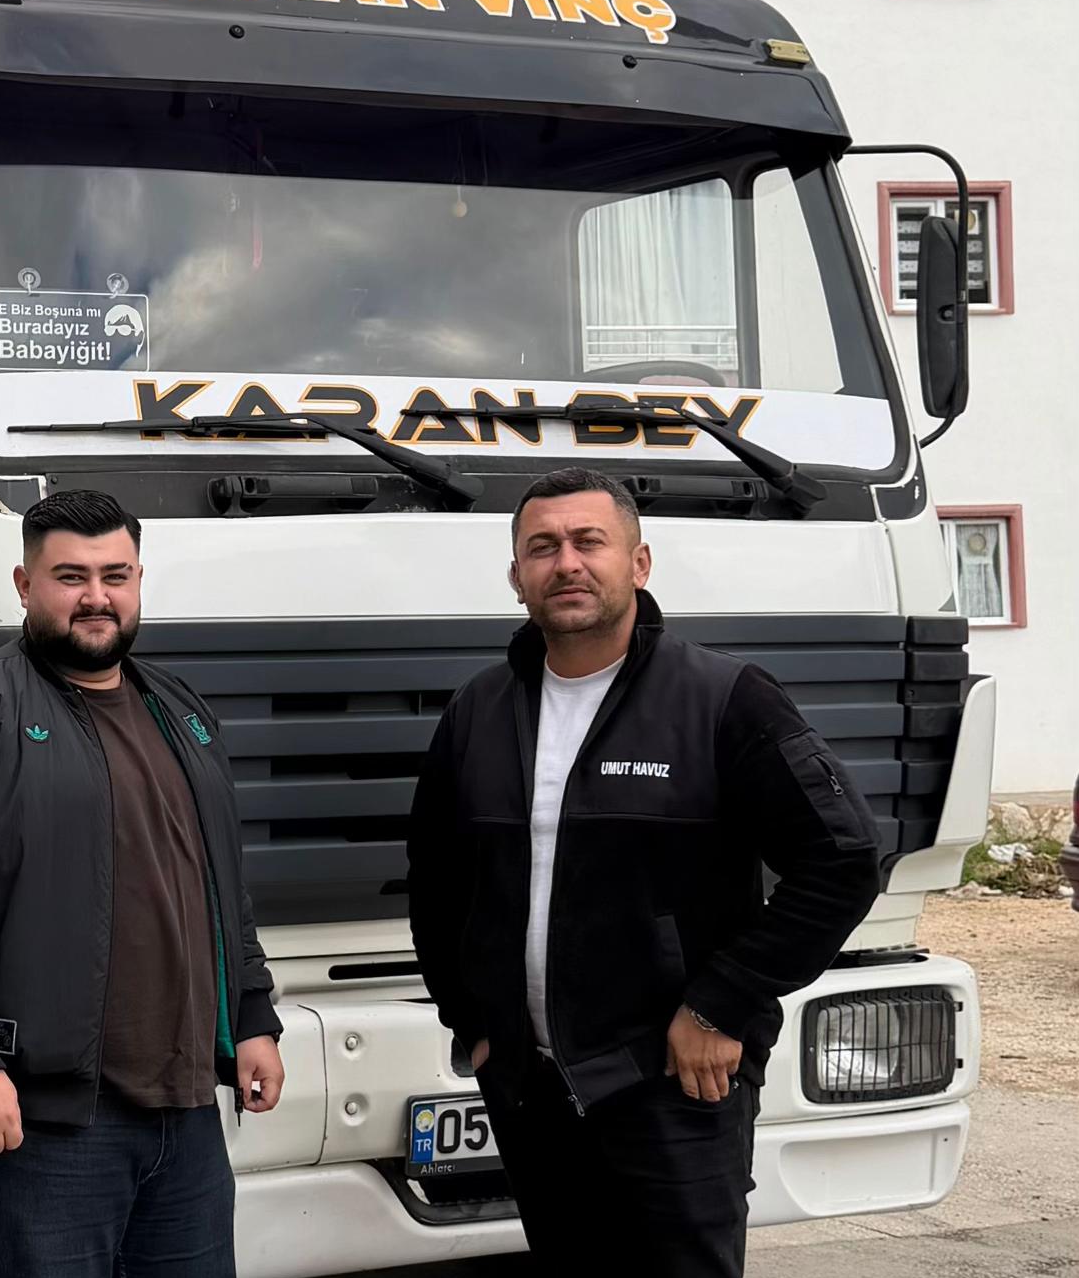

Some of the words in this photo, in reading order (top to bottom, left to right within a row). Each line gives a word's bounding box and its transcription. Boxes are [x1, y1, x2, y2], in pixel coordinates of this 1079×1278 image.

[11, 303, 31, 316] Biz
[35, 304, 83, 319] Boşuna
[86, 307, 101, 318] mı
[0, 339, 111, 365] Babayiğit!
[132, 379, 545, 447] KARAN
[569, 389, 764, 449] BEY
[600, 761, 632, 775] UMUT
[632, 761, 670, 778] HAVUZ
[436, 1105, 489, 1154] 05
[415, 1138, 432, 1153] TR
